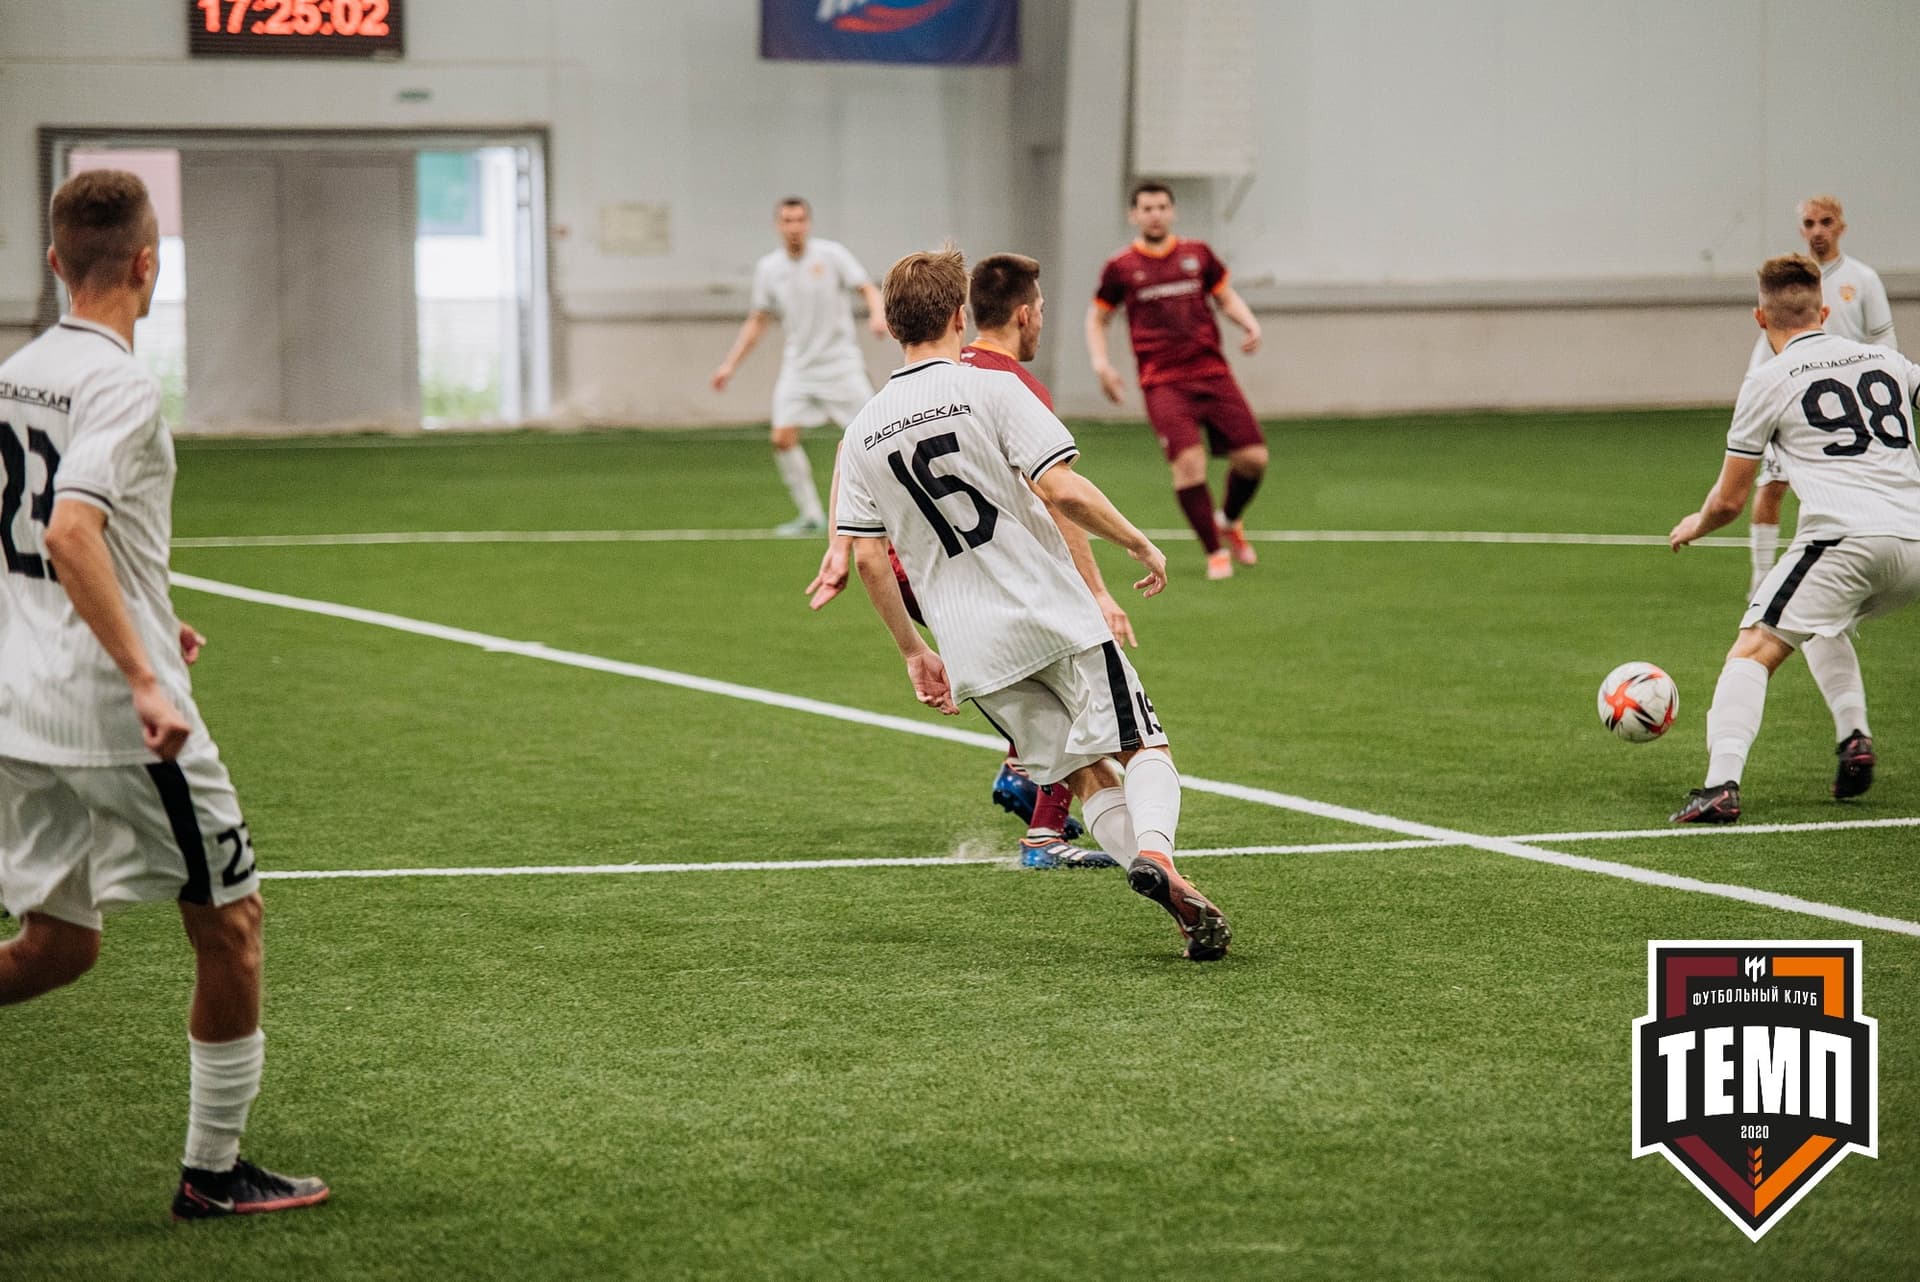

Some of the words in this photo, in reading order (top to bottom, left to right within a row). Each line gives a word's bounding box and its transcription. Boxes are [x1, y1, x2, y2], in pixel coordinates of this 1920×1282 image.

[197, 0, 390, 36] 17:25:02
[1801, 369, 1912, 456] 98
[887, 431, 998, 559] 15
[216, 821, 256, 888] 2
